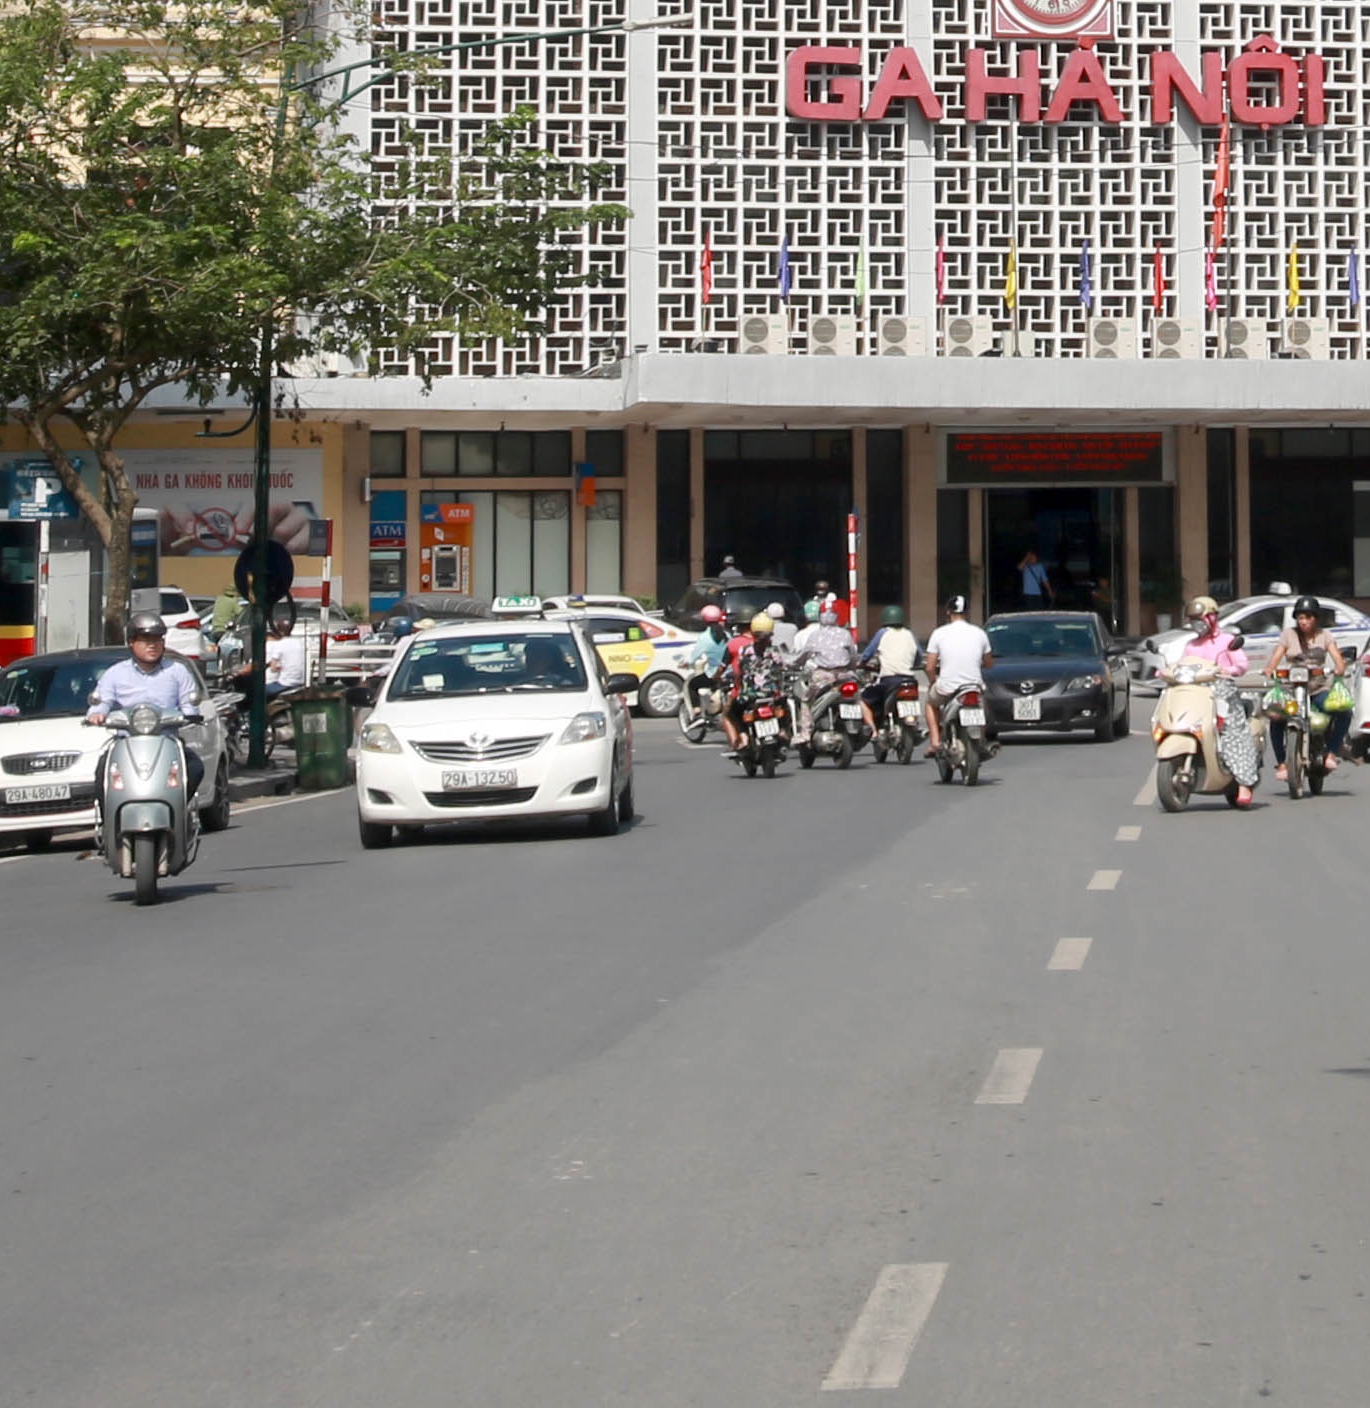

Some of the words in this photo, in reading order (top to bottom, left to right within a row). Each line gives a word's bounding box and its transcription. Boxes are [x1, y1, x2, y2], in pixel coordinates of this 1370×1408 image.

[786, 46, 943, 121] GA
[965, 36, 1124, 122] HÀ
[1152, 34, 1325, 130] NỘI
[164, 472, 180, 489] GA
[35, 477, 62, 503] P
[447, 508, 470, 518] ATM
[373, 525, 402, 536] ATM
[503, 597, 537, 607] TAXI
